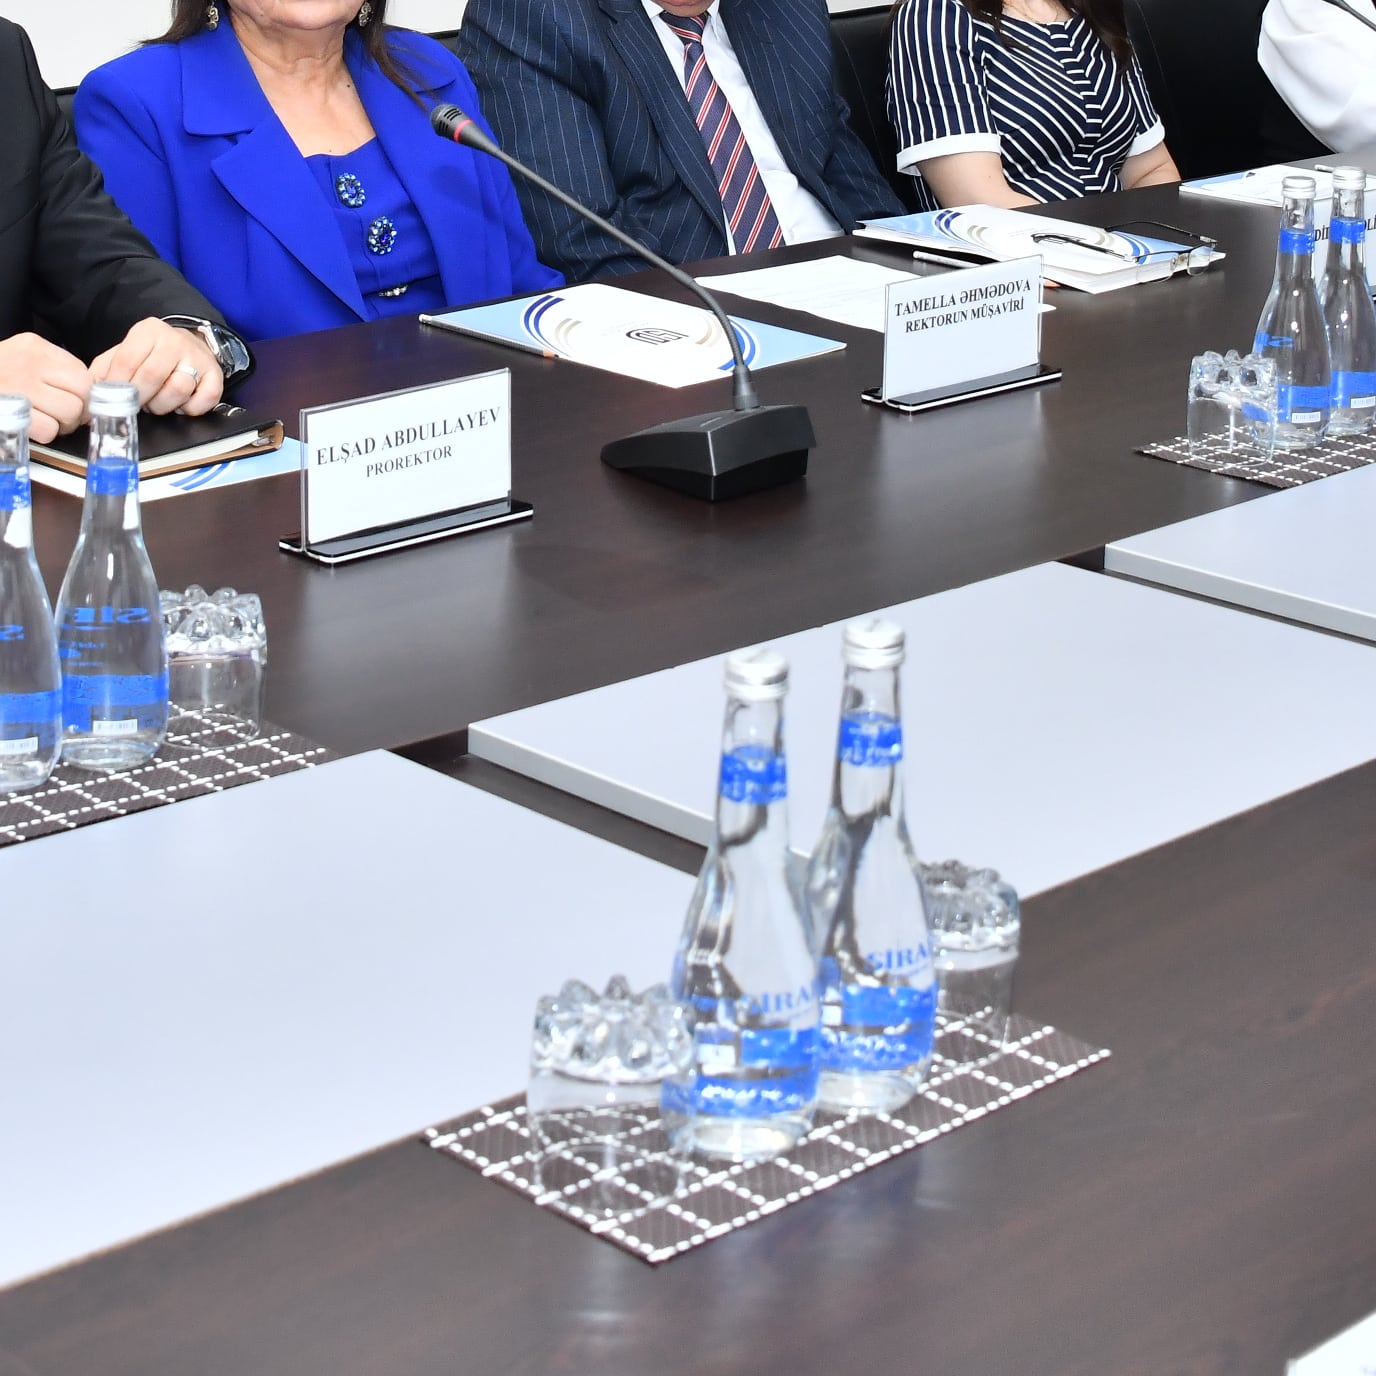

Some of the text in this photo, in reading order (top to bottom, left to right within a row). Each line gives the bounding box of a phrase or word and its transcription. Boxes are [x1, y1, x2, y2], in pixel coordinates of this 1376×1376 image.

[895, 279, 1031, 316] TAMELLA ƏHMƏDOVA
[905, 297, 1025, 333] REKTORUN MÜŞAVİRİ
[317, 406, 501, 465] ELŞAD ABDULLAYEV
[366, 445, 453, 477] PROREKTOR
